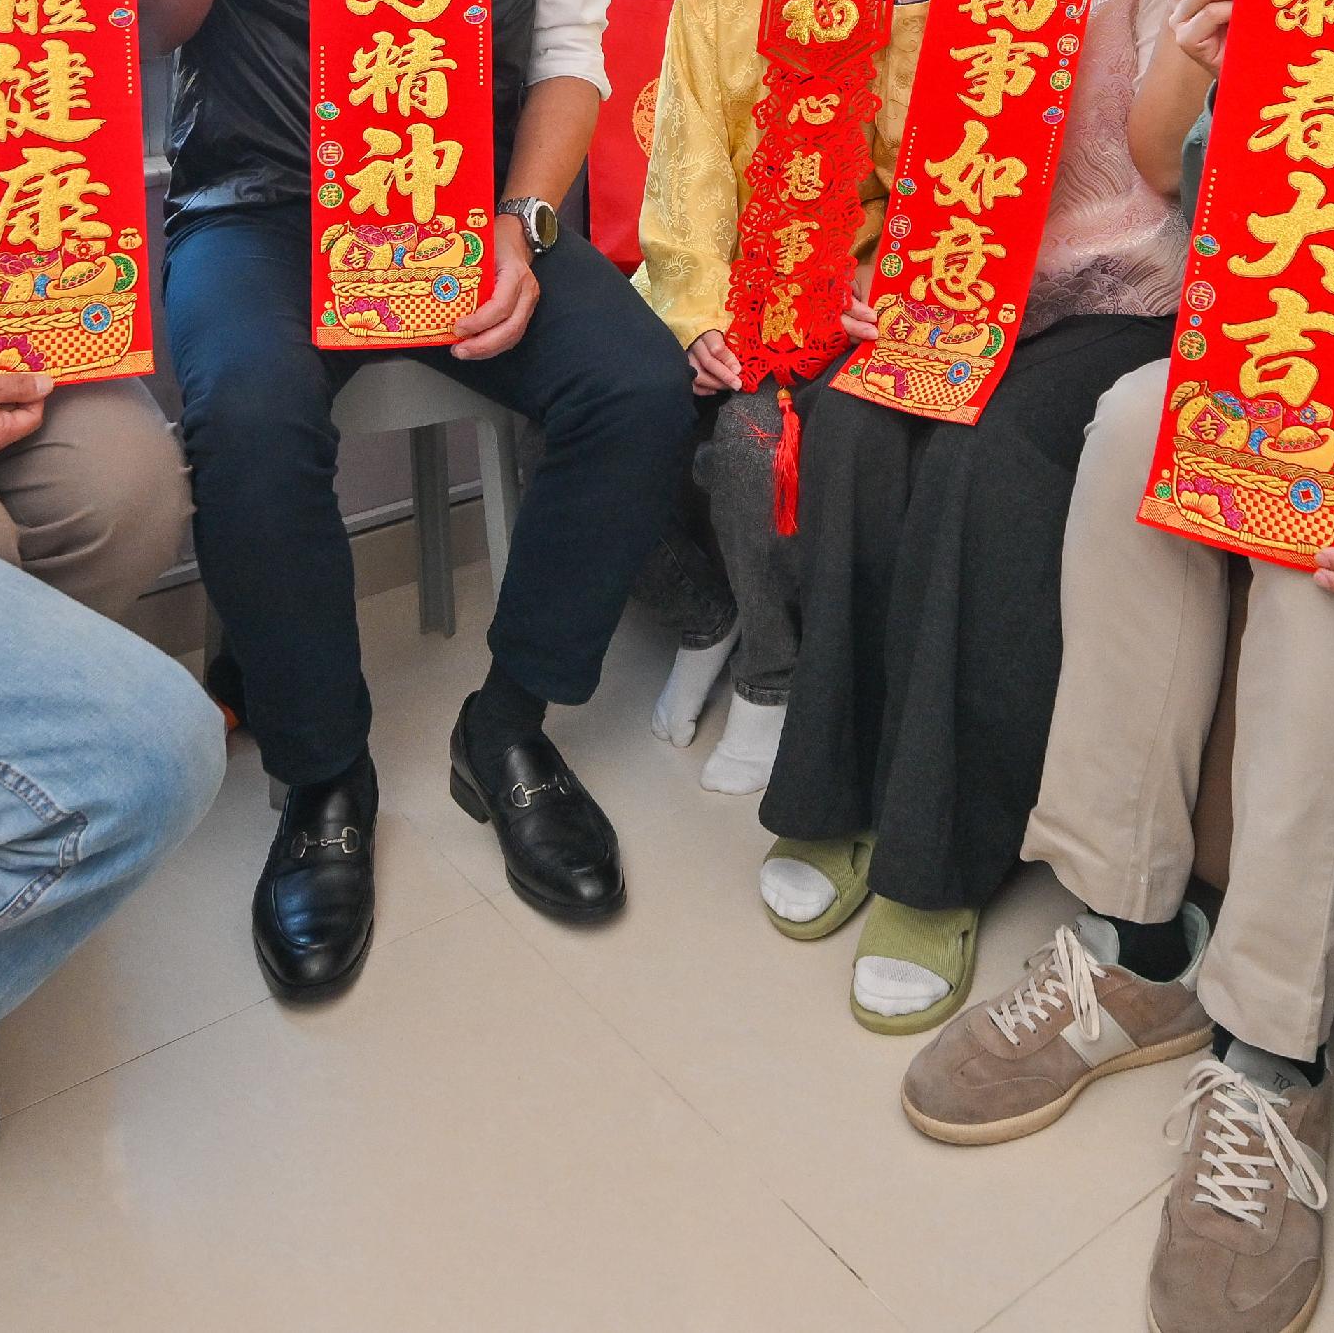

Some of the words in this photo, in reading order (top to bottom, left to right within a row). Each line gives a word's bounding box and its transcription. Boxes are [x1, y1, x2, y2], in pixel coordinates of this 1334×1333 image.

[347, 247, 369, 269] 吉
[893, 319, 911, 340] 吉
[1197, 415, 1221, 441] 吉
